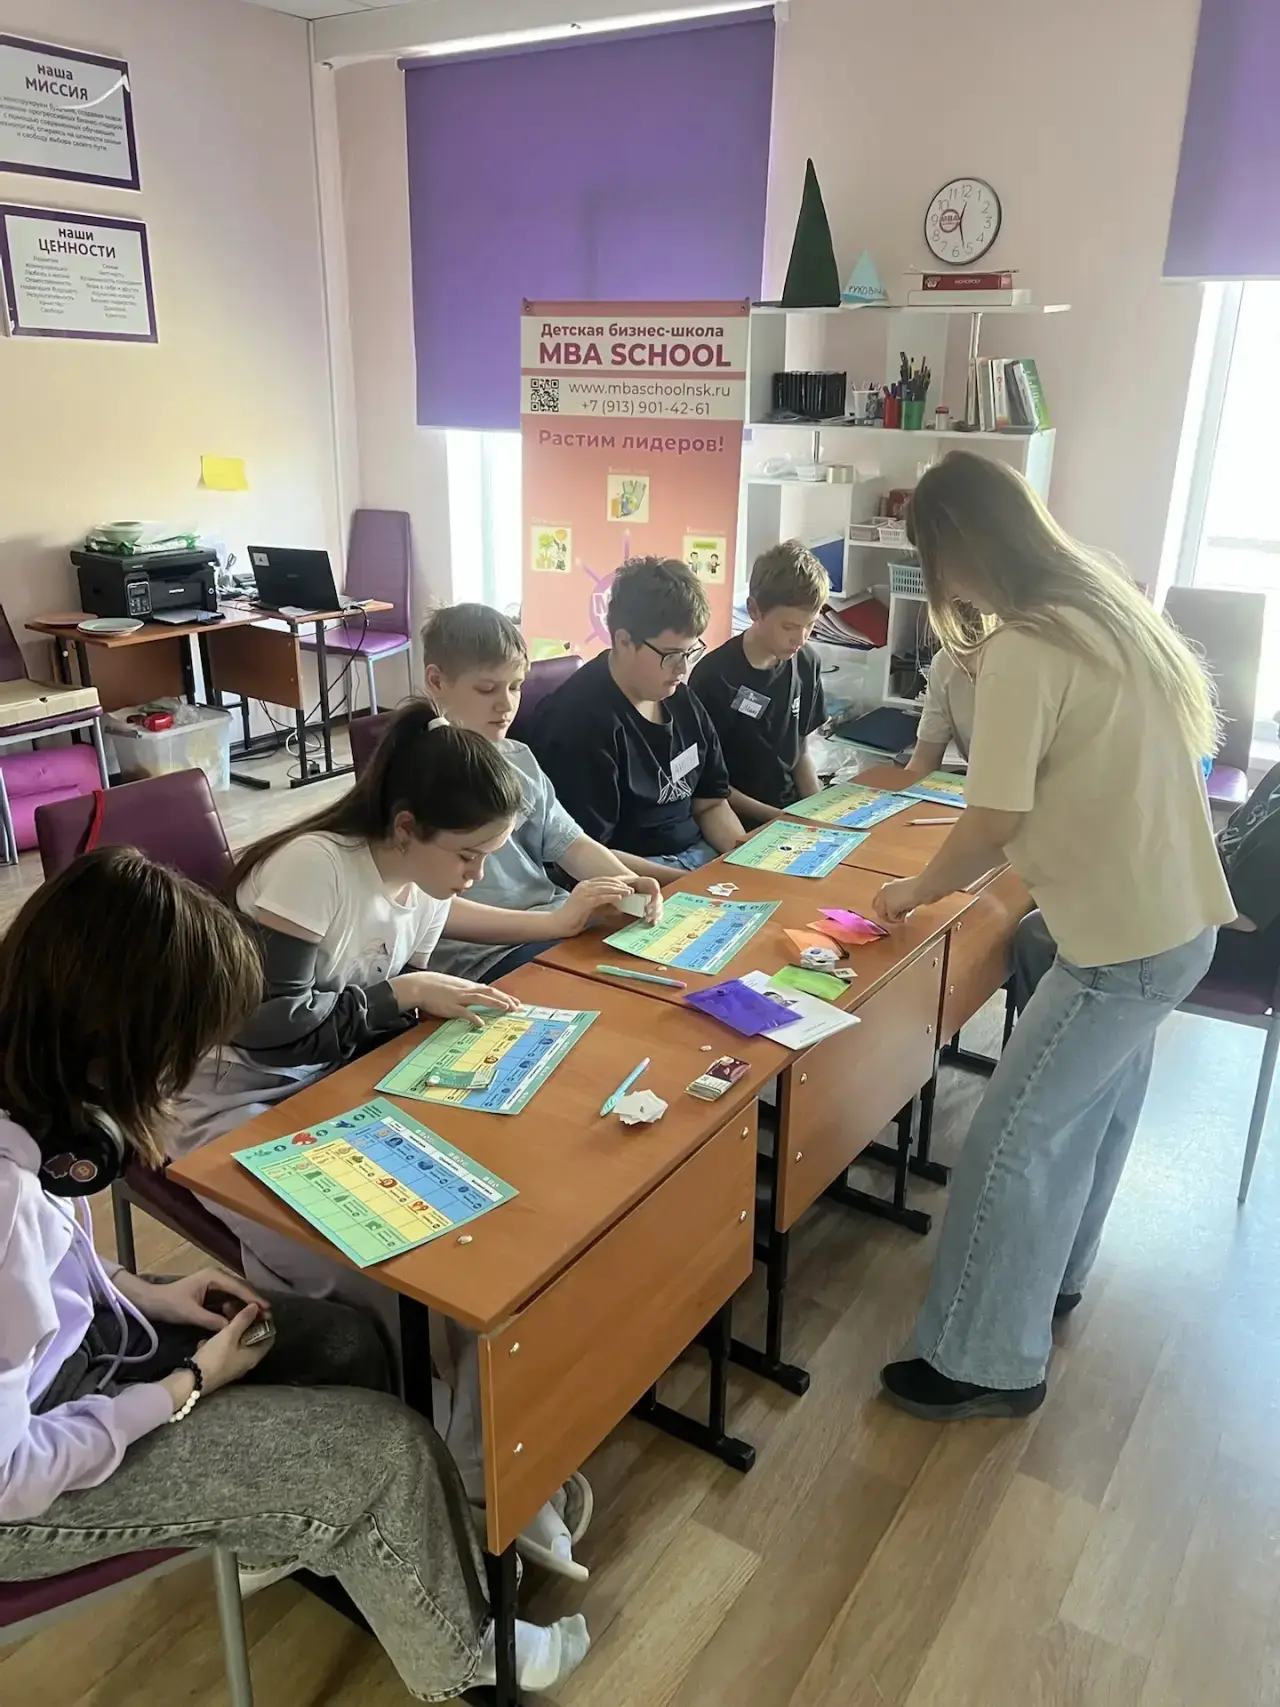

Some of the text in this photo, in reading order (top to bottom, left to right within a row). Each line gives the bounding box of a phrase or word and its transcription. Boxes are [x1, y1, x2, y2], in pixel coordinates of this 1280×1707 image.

[37, 64, 74, 80] наша
[25, 76, 88, 101] МИССИЯ
[949, 188, 958, 201] 11
[962, 184, 973, 198] 12
[976, 189, 982, 202] 1
[981, 201, 991, 214] 2
[931, 213, 939, 227] 9
[983, 216, 993, 229] 3
[58, 227, 94, 241] наши
[932, 229, 941, 242] 8
[976, 232, 984, 244] 4
[38, 238, 116, 259] ЦЕННОСТИ
[941, 240, 948, 252] 7
[952, 245, 960, 258] 6
[965, 242, 974, 255] 5
[541, 323, 724, 338] Детская бизнес-школа
[539, 342, 732, 367] MBA SCHOOL
[568, 382, 731, 397] www.mbaschoolnsk.ru
[582, 400, 710, 416] +7 (913) 901-42-61
[538, 429, 725, 455] Растим лидеров!
